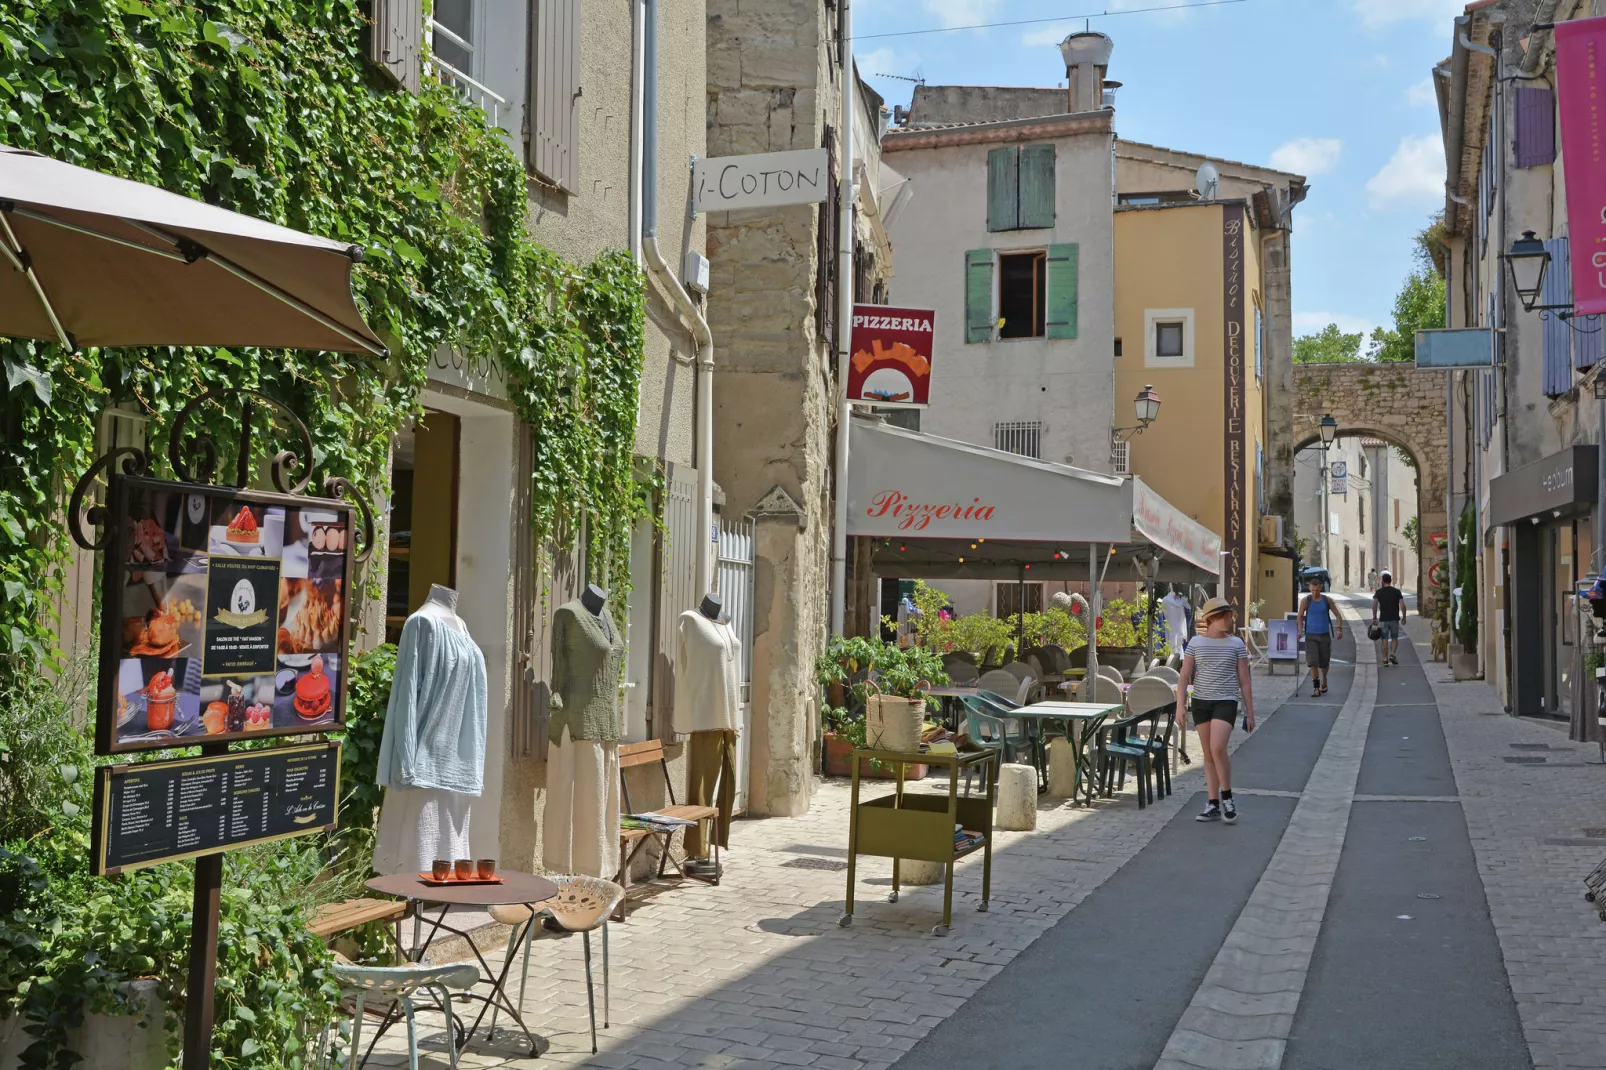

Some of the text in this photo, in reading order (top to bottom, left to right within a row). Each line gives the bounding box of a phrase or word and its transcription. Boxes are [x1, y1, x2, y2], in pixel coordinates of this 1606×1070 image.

[853, 315, 932, 332] PIZZERIA
[867, 489, 996, 531] Pizzeria
[1229, 439, 1240, 540] RESTAURANT
[1230, 547, 1240, 588] CAVE
